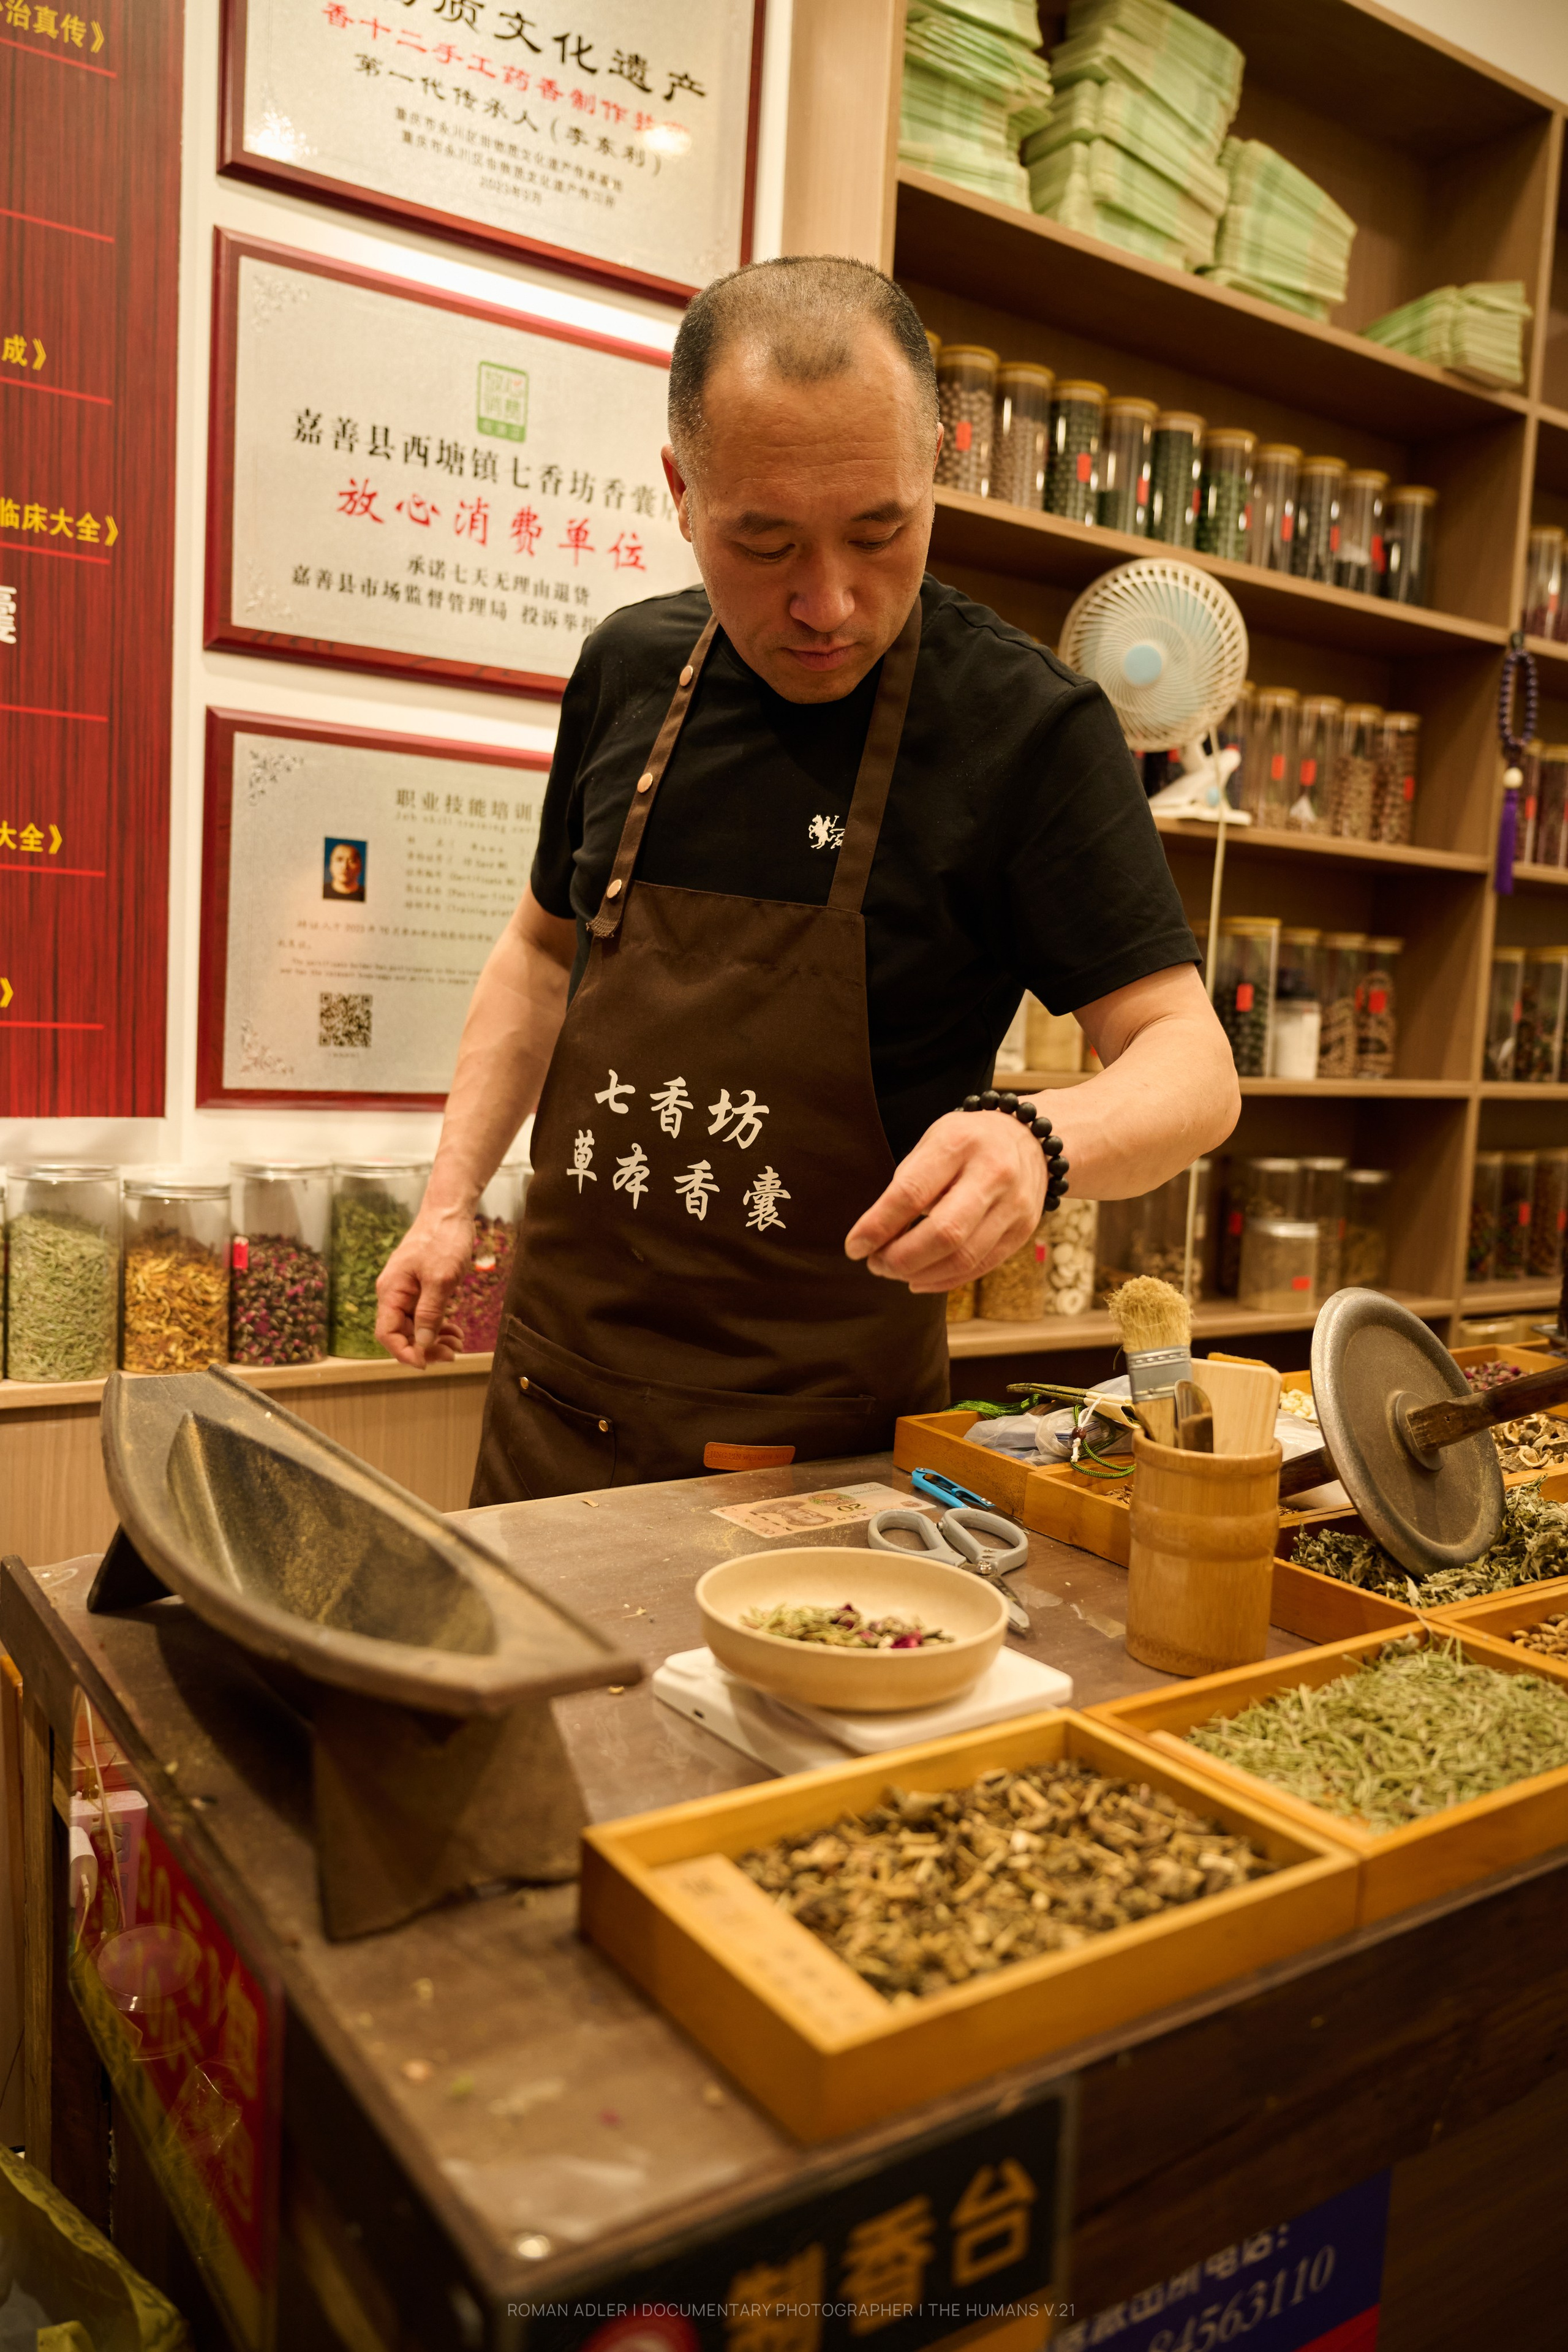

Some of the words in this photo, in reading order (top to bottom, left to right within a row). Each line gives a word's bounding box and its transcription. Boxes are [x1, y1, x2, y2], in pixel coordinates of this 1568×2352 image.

[0, 0, 105, 53] 治真传》
[401, 0, 707, 101] 质文化遗产
[322, 1, 690, 132] 香十二手工药香制作技
[2, 334, 47, 371] 成》
[336, 478, 647, 572] 放心消费单位
[292, 564, 507, 621] 嘉善县市场监督管理局
[408, 554, 589, 607] 承诺七天无理由退货
[396, 788, 542, 823] 职业技能培训
[595, 1069, 769, 1149] 七香坊
[567, 1129, 791, 1232] 草本香囊
[837, 1503, 867, 1512] 20
